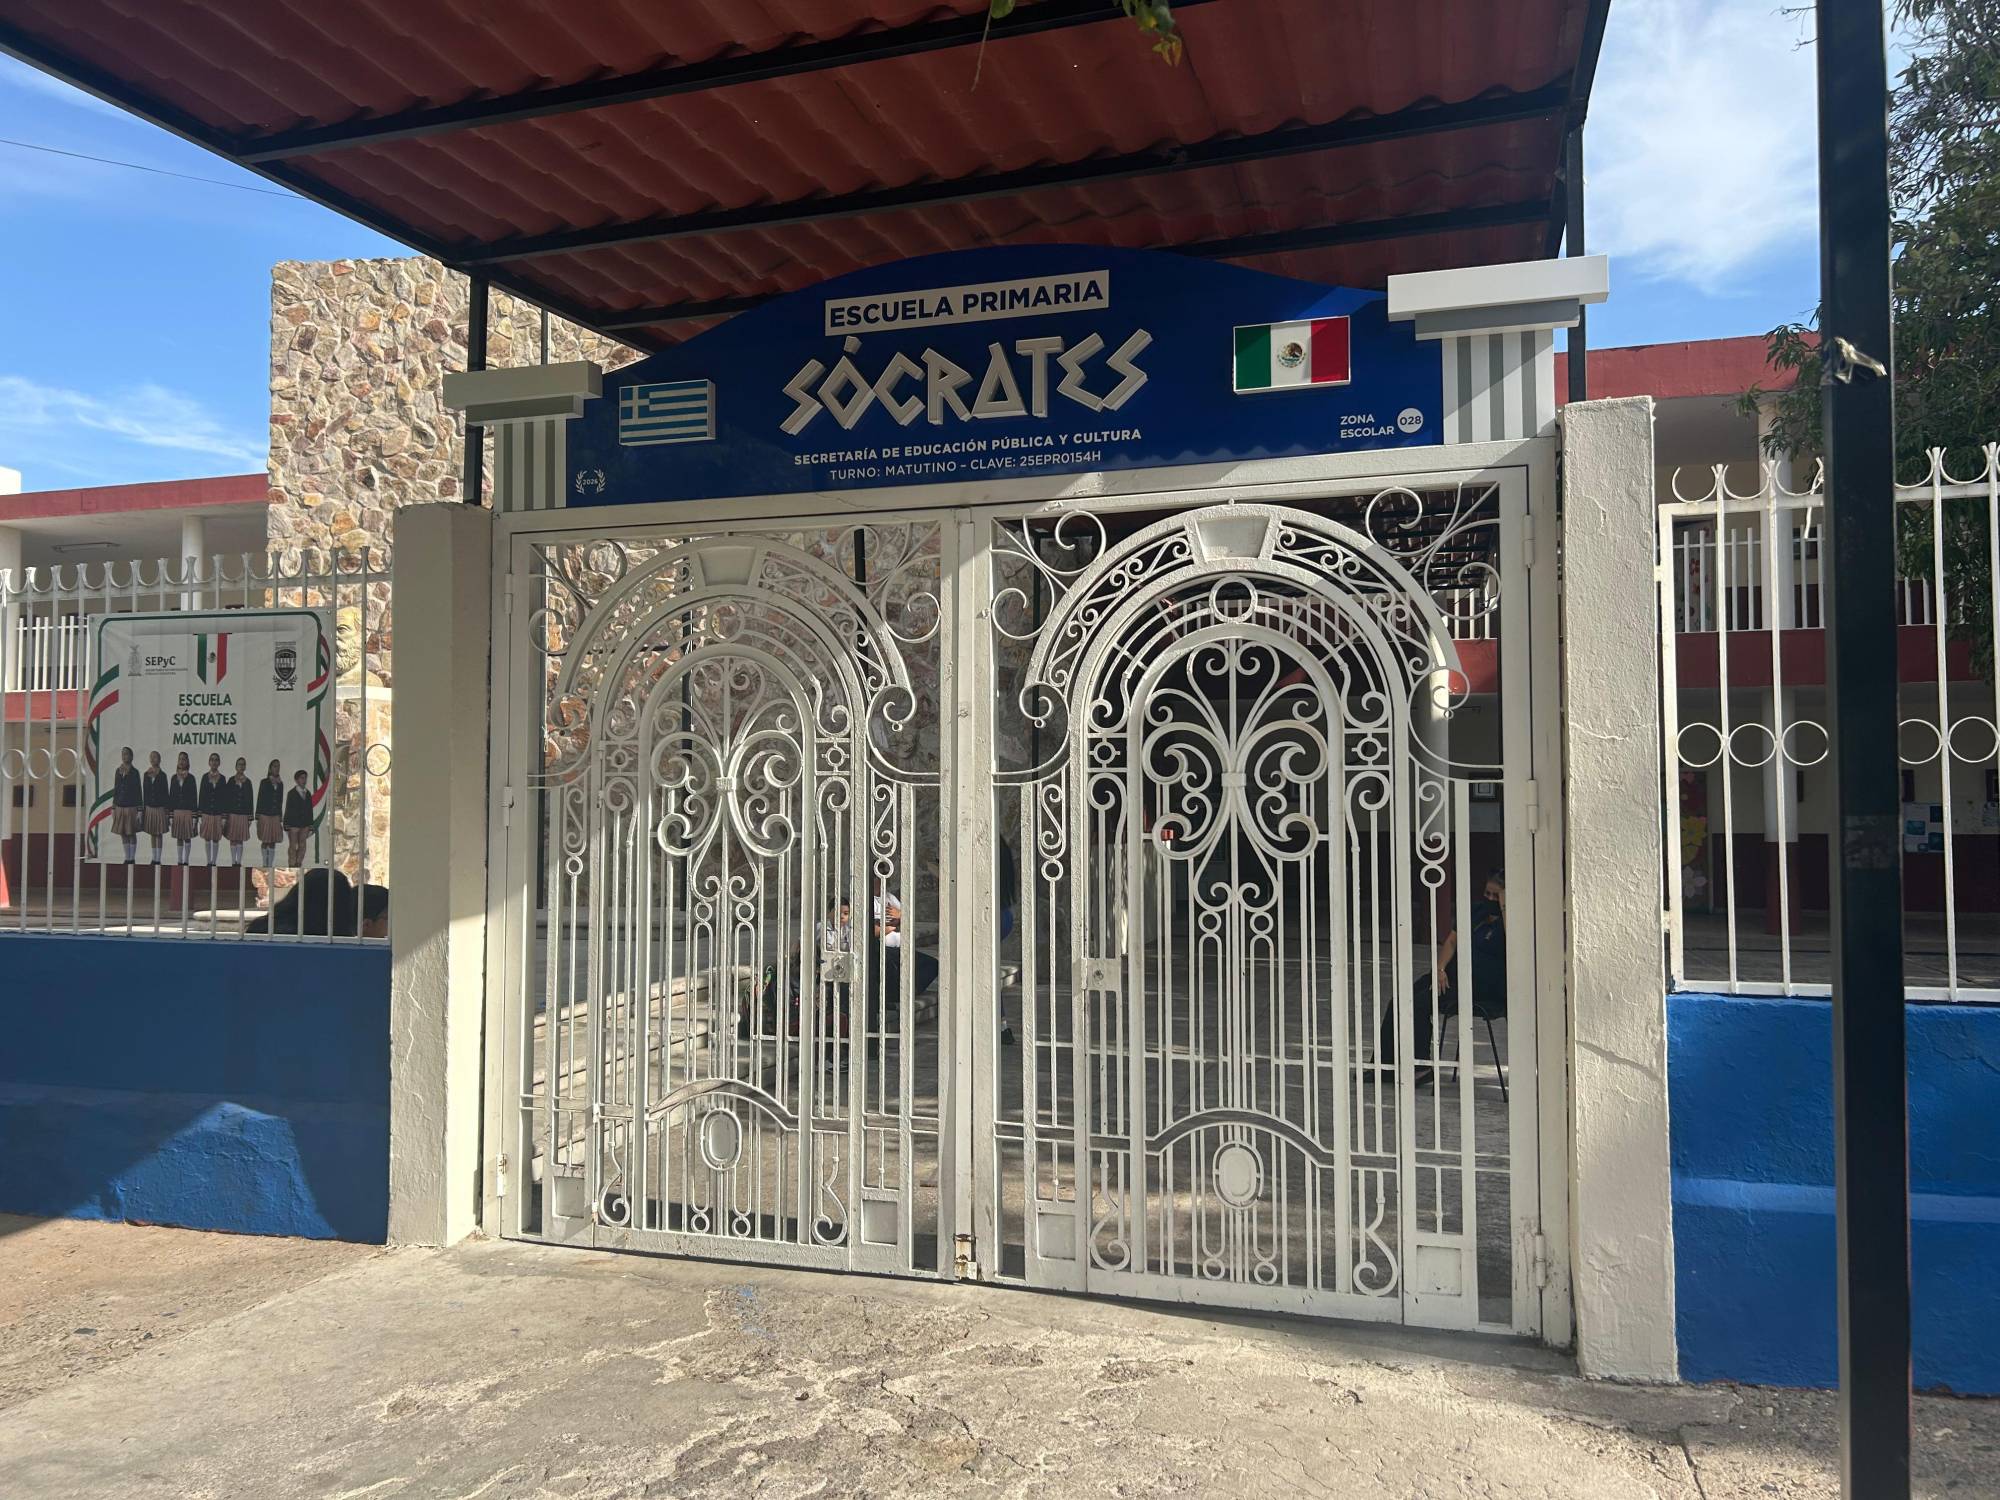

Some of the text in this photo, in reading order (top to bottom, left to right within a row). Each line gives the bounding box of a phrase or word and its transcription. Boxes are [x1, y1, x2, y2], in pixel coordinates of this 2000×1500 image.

[829, 279, 1104, 328] ESCUELA PRIMARIA
[779, 328, 1153, 436] SÓCRATES
[1340, 414, 1375, 425] ZONA
[1399, 415, 1422, 426] 028
[1340, 425, 1395, 439] ESCOLAR
[794, 428, 1142, 466] SECRETARÍA DE EDUCACIÓN PÚBLICA Y CULTURA
[829, 467, 881, 481] TURNO:
[885, 460, 957, 477] MATUTINO
[970, 457, 1016, 471] CLAVE:
[145, 655, 176, 668] SEPyC
[178, 693, 232, 708] ESCUELA
[173, 709, 237, 726] SÓCRATES
[172, 732, 237, 746] MATUTINA
